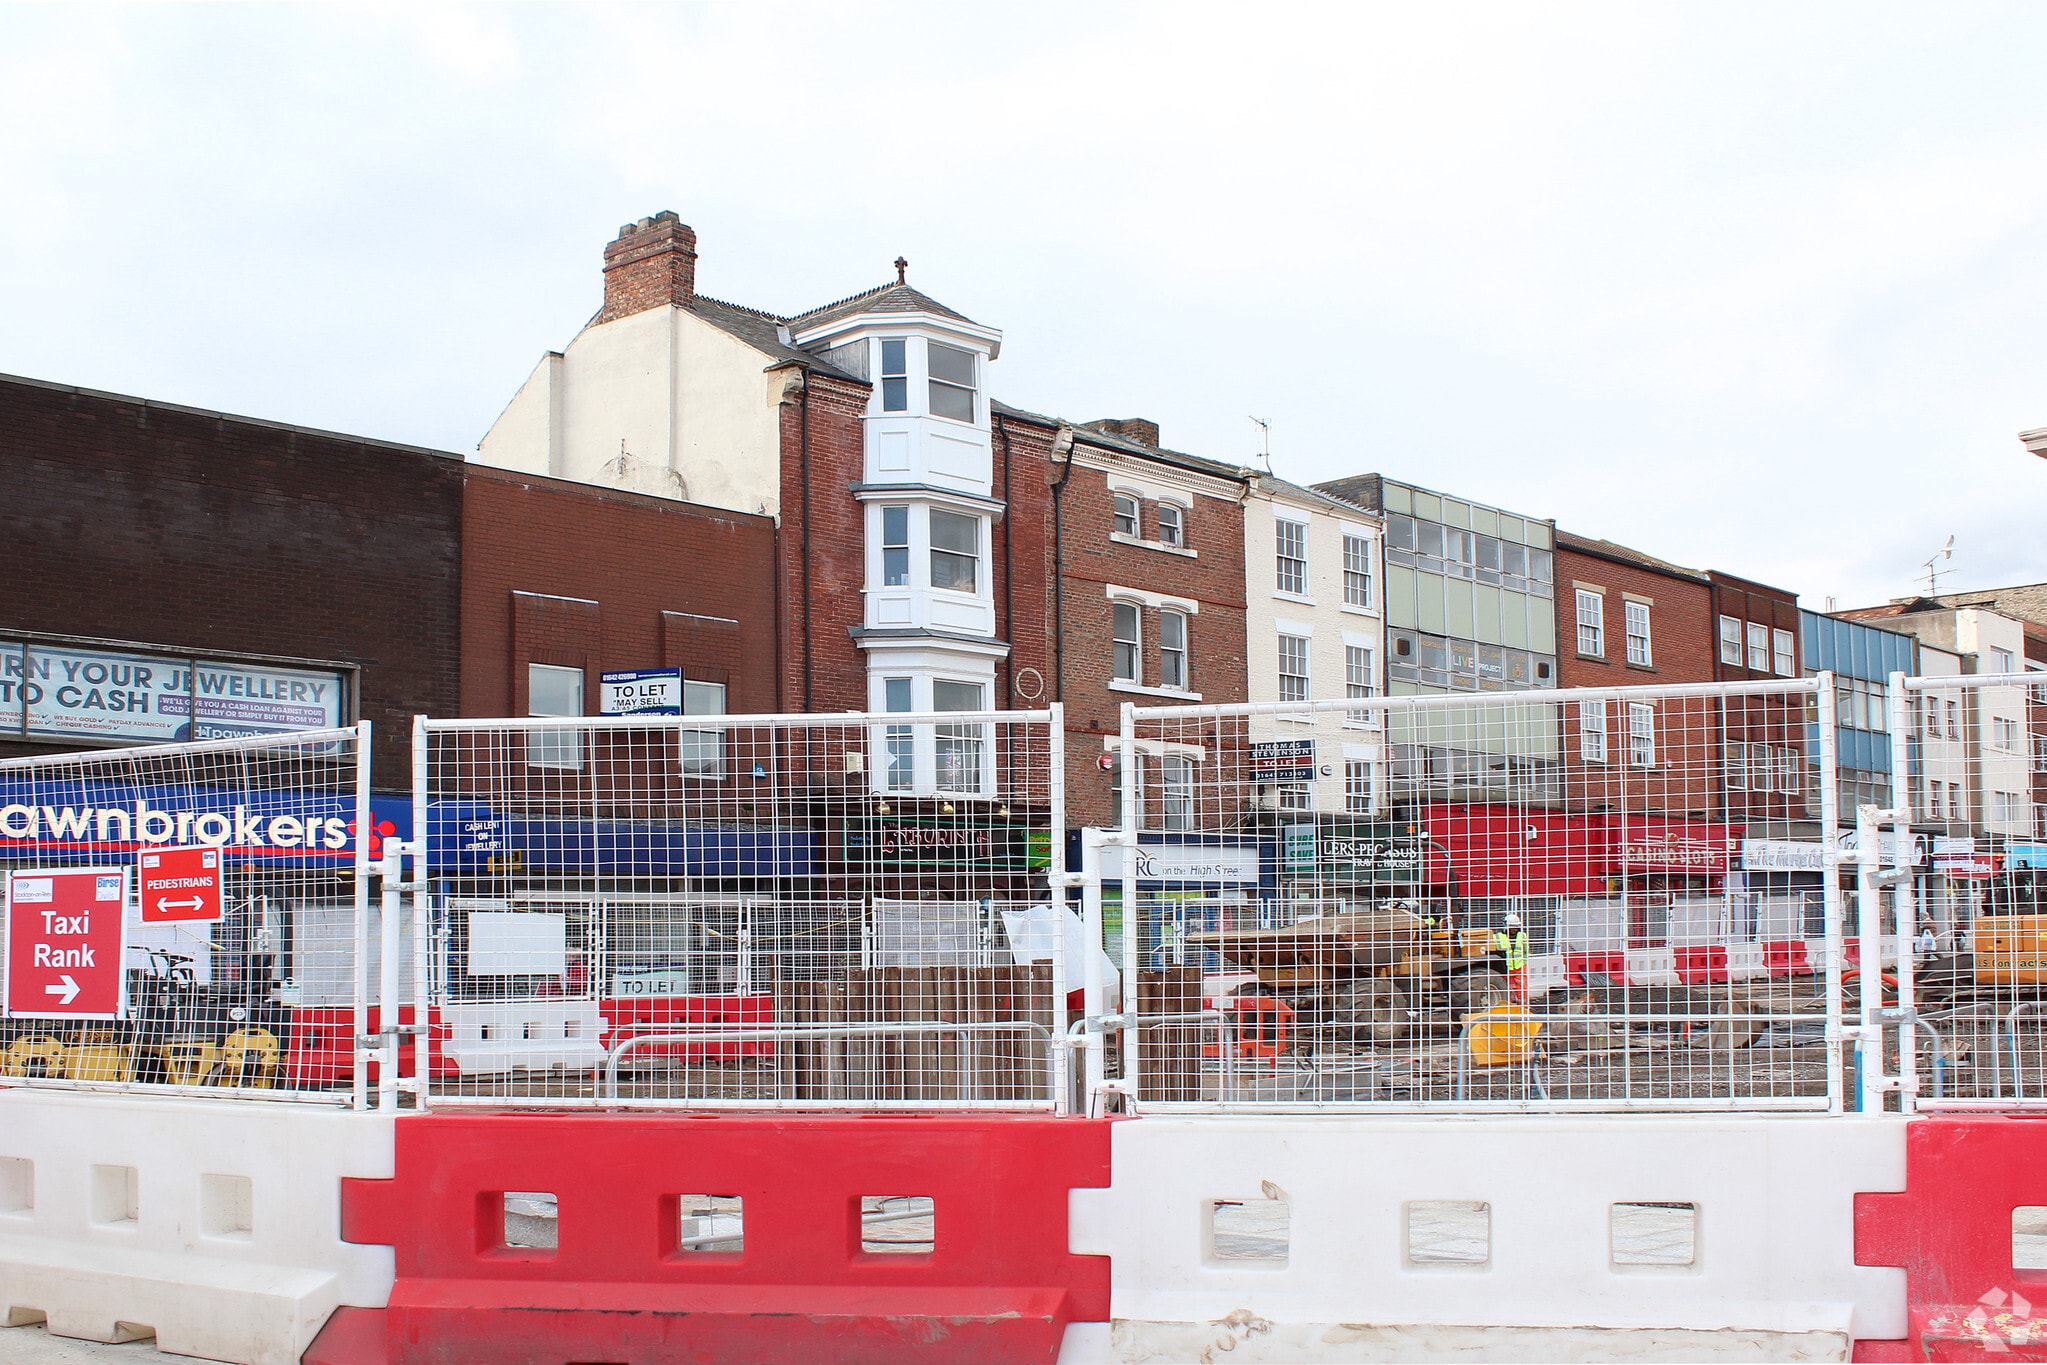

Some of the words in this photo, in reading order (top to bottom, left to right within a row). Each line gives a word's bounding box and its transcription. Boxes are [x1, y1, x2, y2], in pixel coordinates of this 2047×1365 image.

[1452, 655, 1474, 668] LIVE
[1478, 662, 1502, 673] PROJECT
[0, 654, 50, 680] RN
[62, 660, 153, 689] YOUR
[163, 669, 327, 703] JEWELLERY
[613, 685, 635, 698] TO
[640, 684, 667, 697] LET
[56, 686, 149, 714] CASH
[162, 705, 184, 713] GOLD
[185, 706, 225, 717] JWELLERY
[238, 711, 262, 719] SIMPLY
[264, 713, 278, 721] BUY
[286, 715, 307, 723] FROM
[185, 699, 204, 707] GVE
[204, 700, 220, 708] YOU
[228, 702, 249, 711] CASH
[250, 704, 270, 712] LOAN
[271, 706, 302, 715] AGAINST
[303, 709, 323, 717] YOUR
[1251, 748, 1309, 758] STEVENSON
[1259, 742, 1301, 751] THOMAS
[465, 822, 483, 832] CASH
[484, 820, 500, 830] LENT
[477, 832, 489, 841] ON
[464, 840, 503, 852] JEWELLERY
[1627, 846, 1677, 864] CASINO
[1680, 848, 1716, 865] SLOTS
[1190, 865, 1212, 878] High
[1215, 864, 1242, 877] Sree
[97, 877, 119, 888] Birse
[147, 876, 214, 890] PEDESTRIANS
[41, 910, 90, 935] Taxi
[34, 943, 96, 968] Rank
[1992, 959, 2047, 968] Conacts
[622, 981, 643, 994] TO
[649, 980, 677, 993] LET
